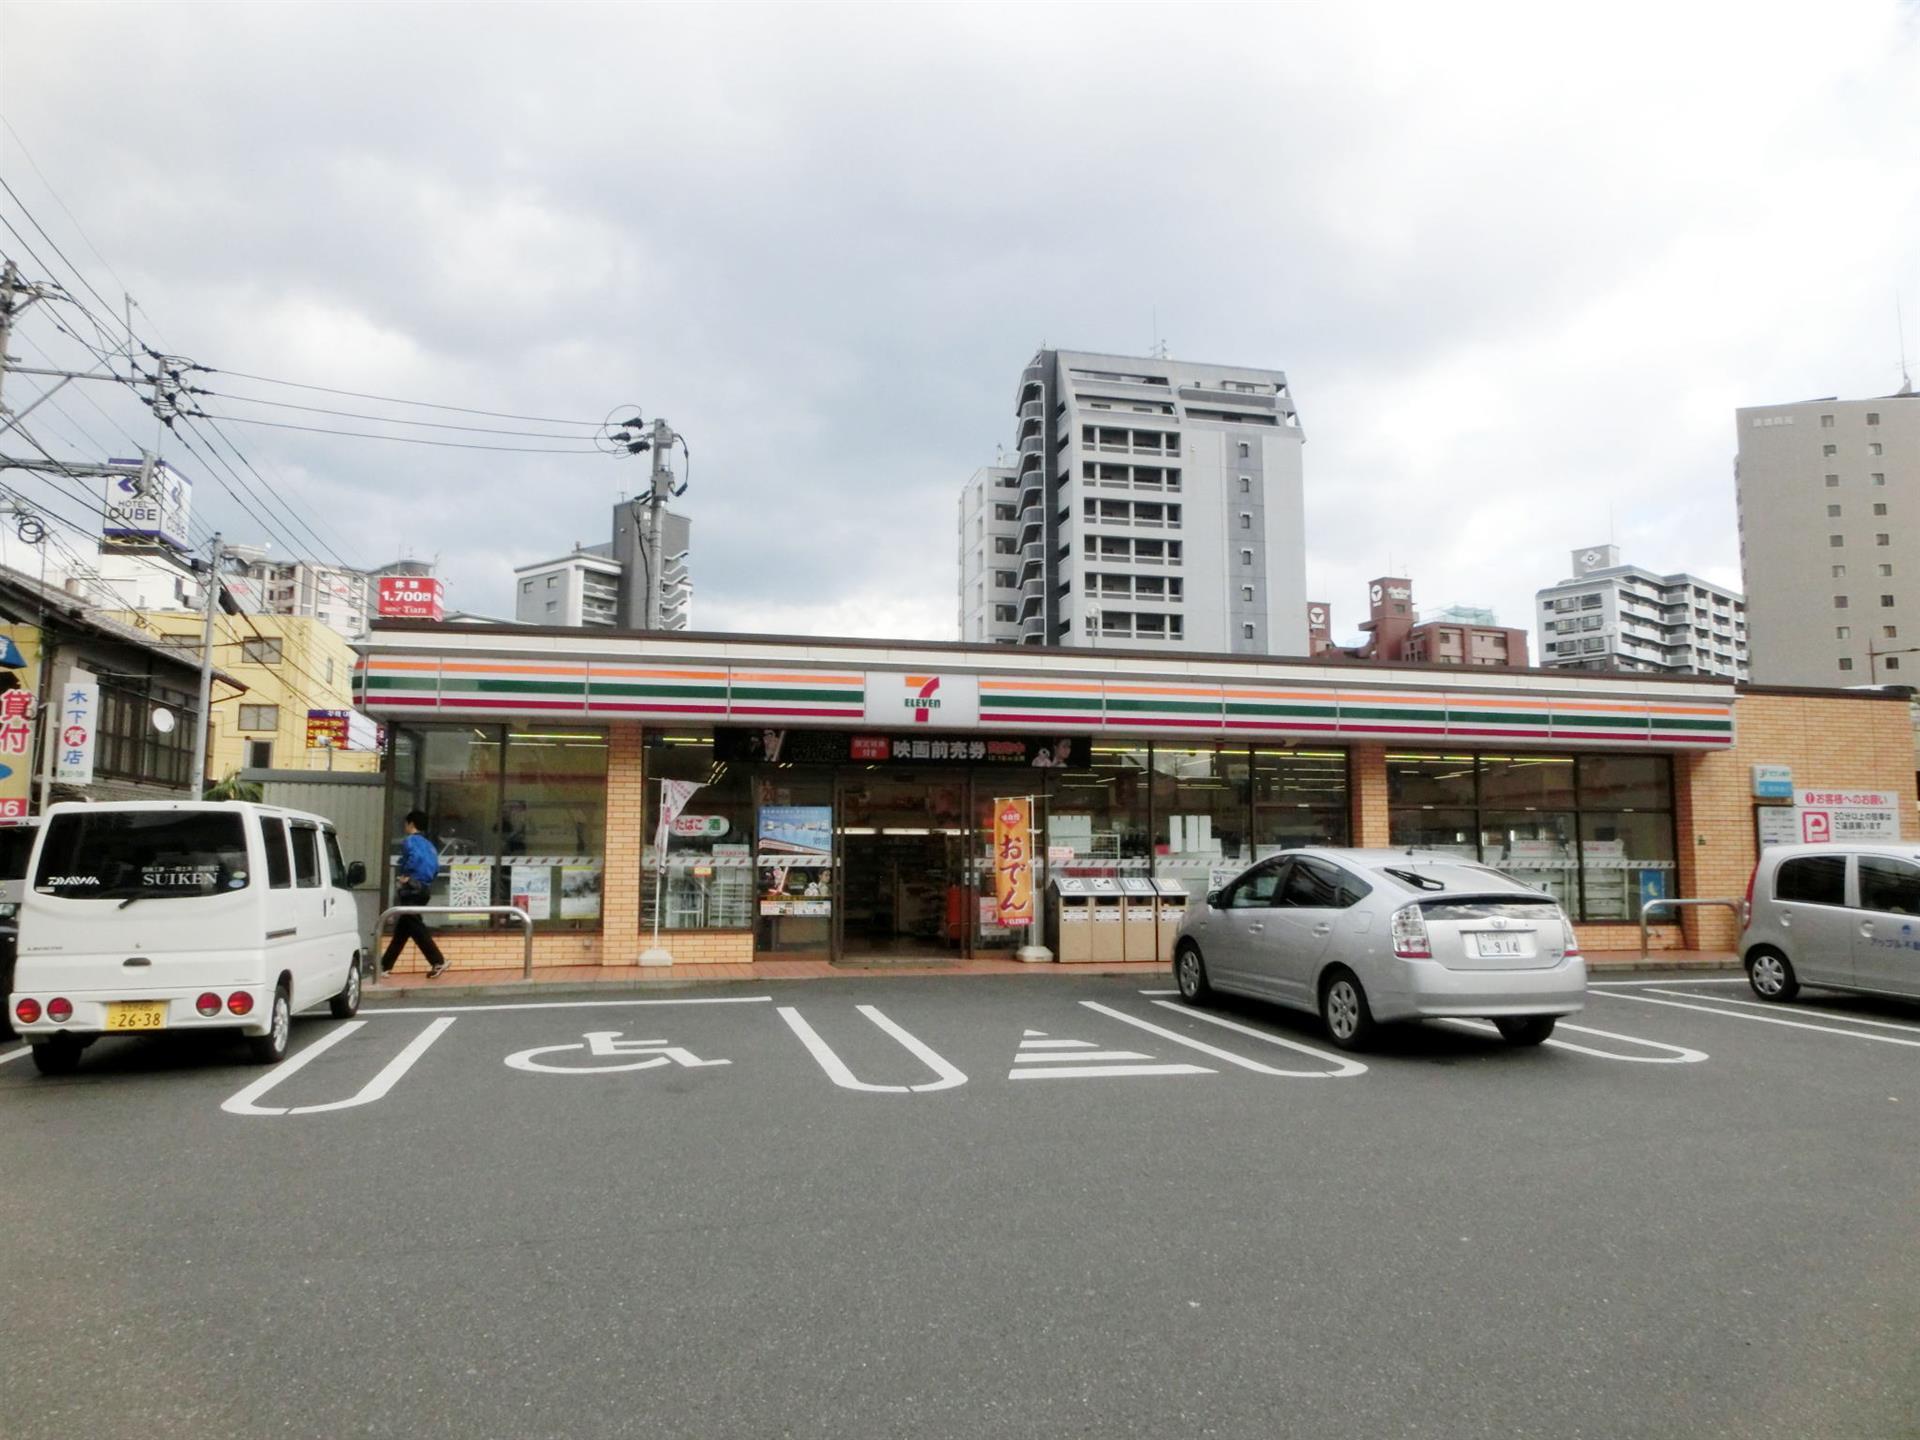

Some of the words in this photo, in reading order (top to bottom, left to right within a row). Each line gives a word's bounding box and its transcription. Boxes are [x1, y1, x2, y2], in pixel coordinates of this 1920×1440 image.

[109, 508, 157, 520] CUBE
[0, 690, 32, 753] 貸付
[893, 740, 987, 759] 映画前売券
[675, 819, 703, 831] たばこ
[143, 872, 218, 886] SUIKEN
[1000, 833, 1027, 911] おでん
